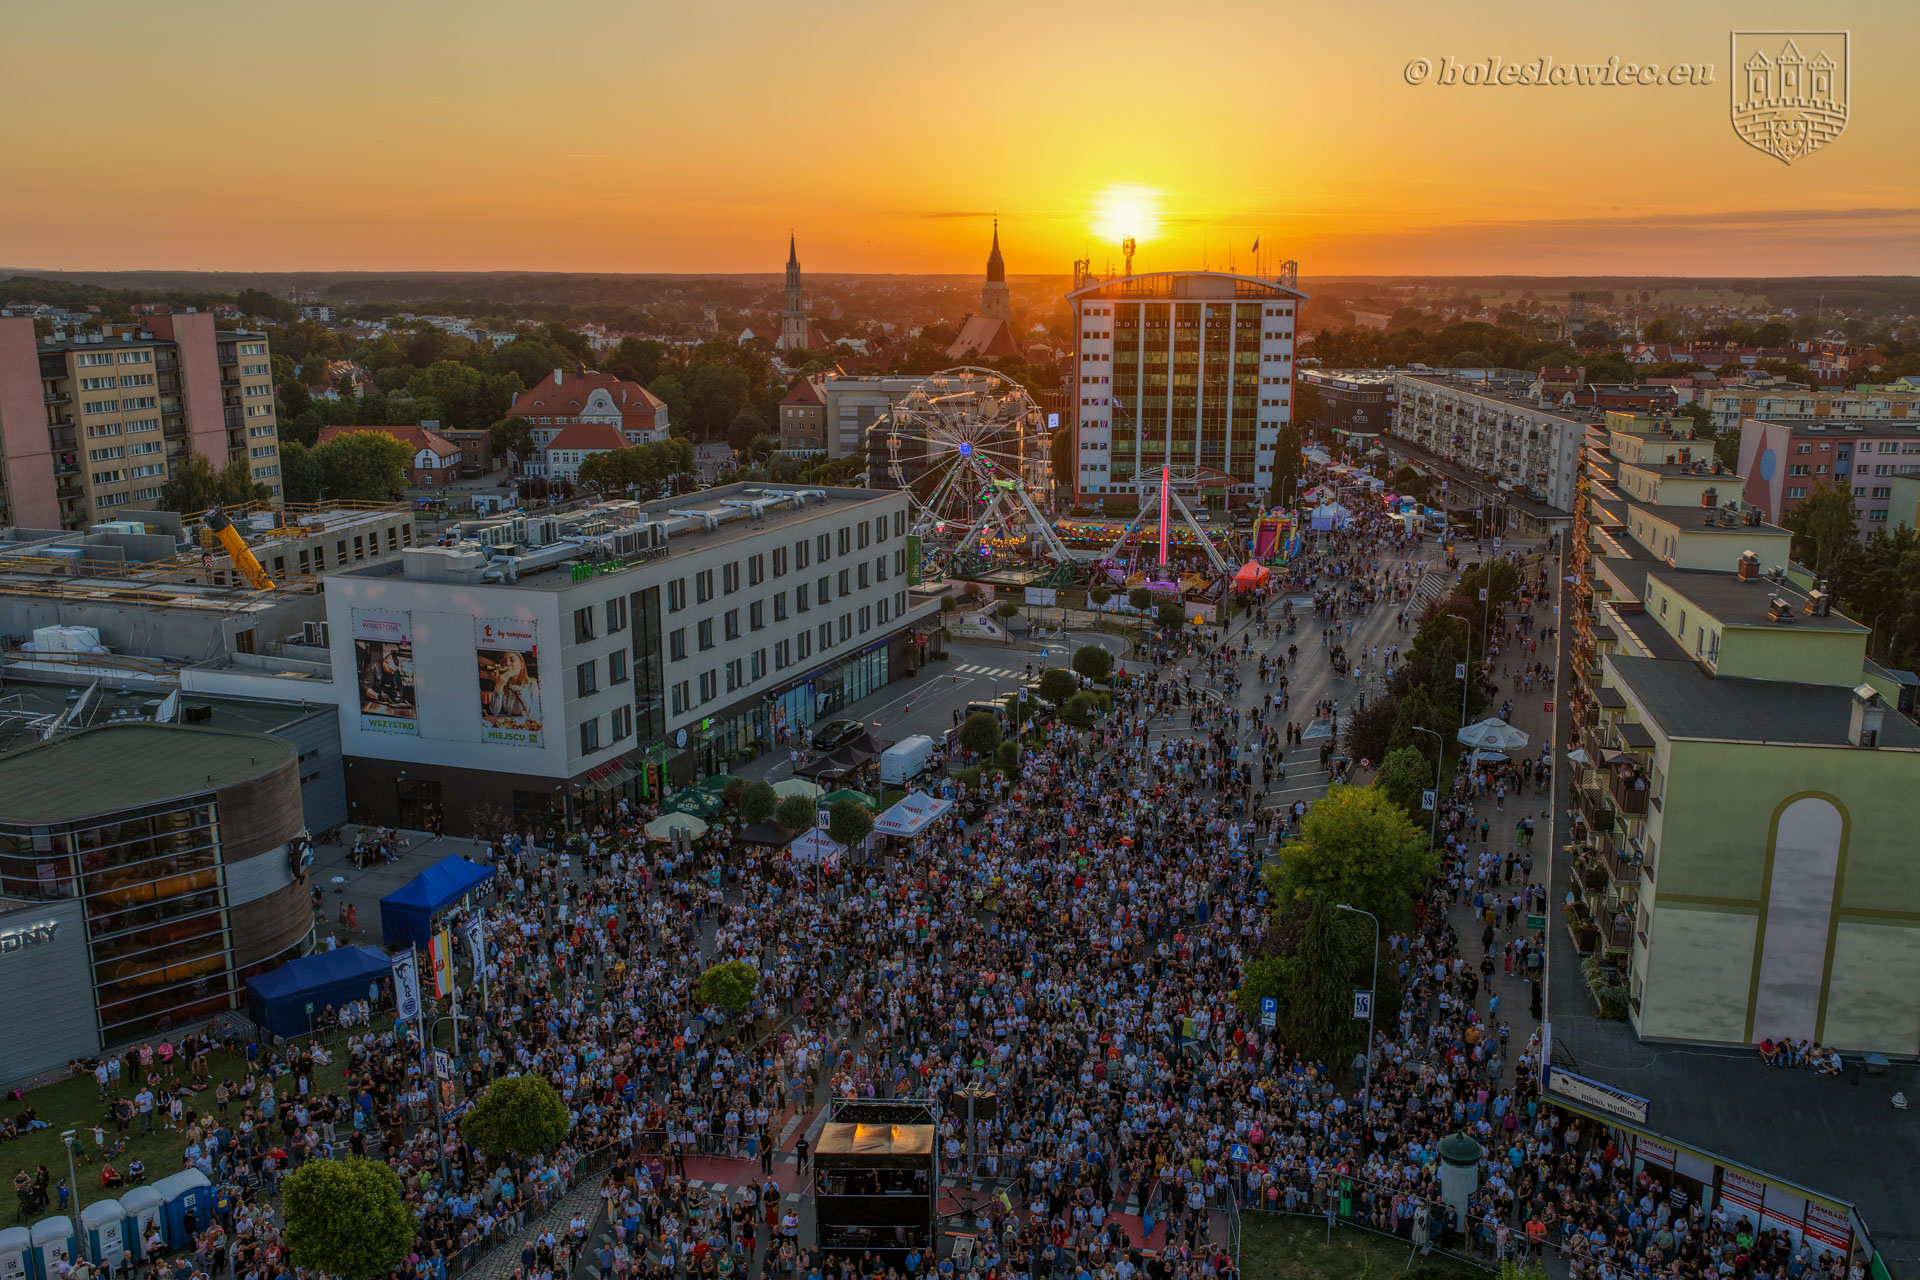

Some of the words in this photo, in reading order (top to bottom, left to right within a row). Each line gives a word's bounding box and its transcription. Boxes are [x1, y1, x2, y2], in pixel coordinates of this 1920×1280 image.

[647, 546, 670, 561] HOTEL
[571, 560, 594, 581] ibis
[362, 622, 399, 631] WINESTONE
[368, 719, 415, 731] WSZYSTKO
[488, 731, 525, 741] MIEJSCU
[0, 923, 59, 952] DNY
[1640, 1138, 1672, 1154] LOMBARD
[1727, 1171, 1762, 1188] LOMBARD
[1811, 1204, 1848, 1222] LOMBARD
